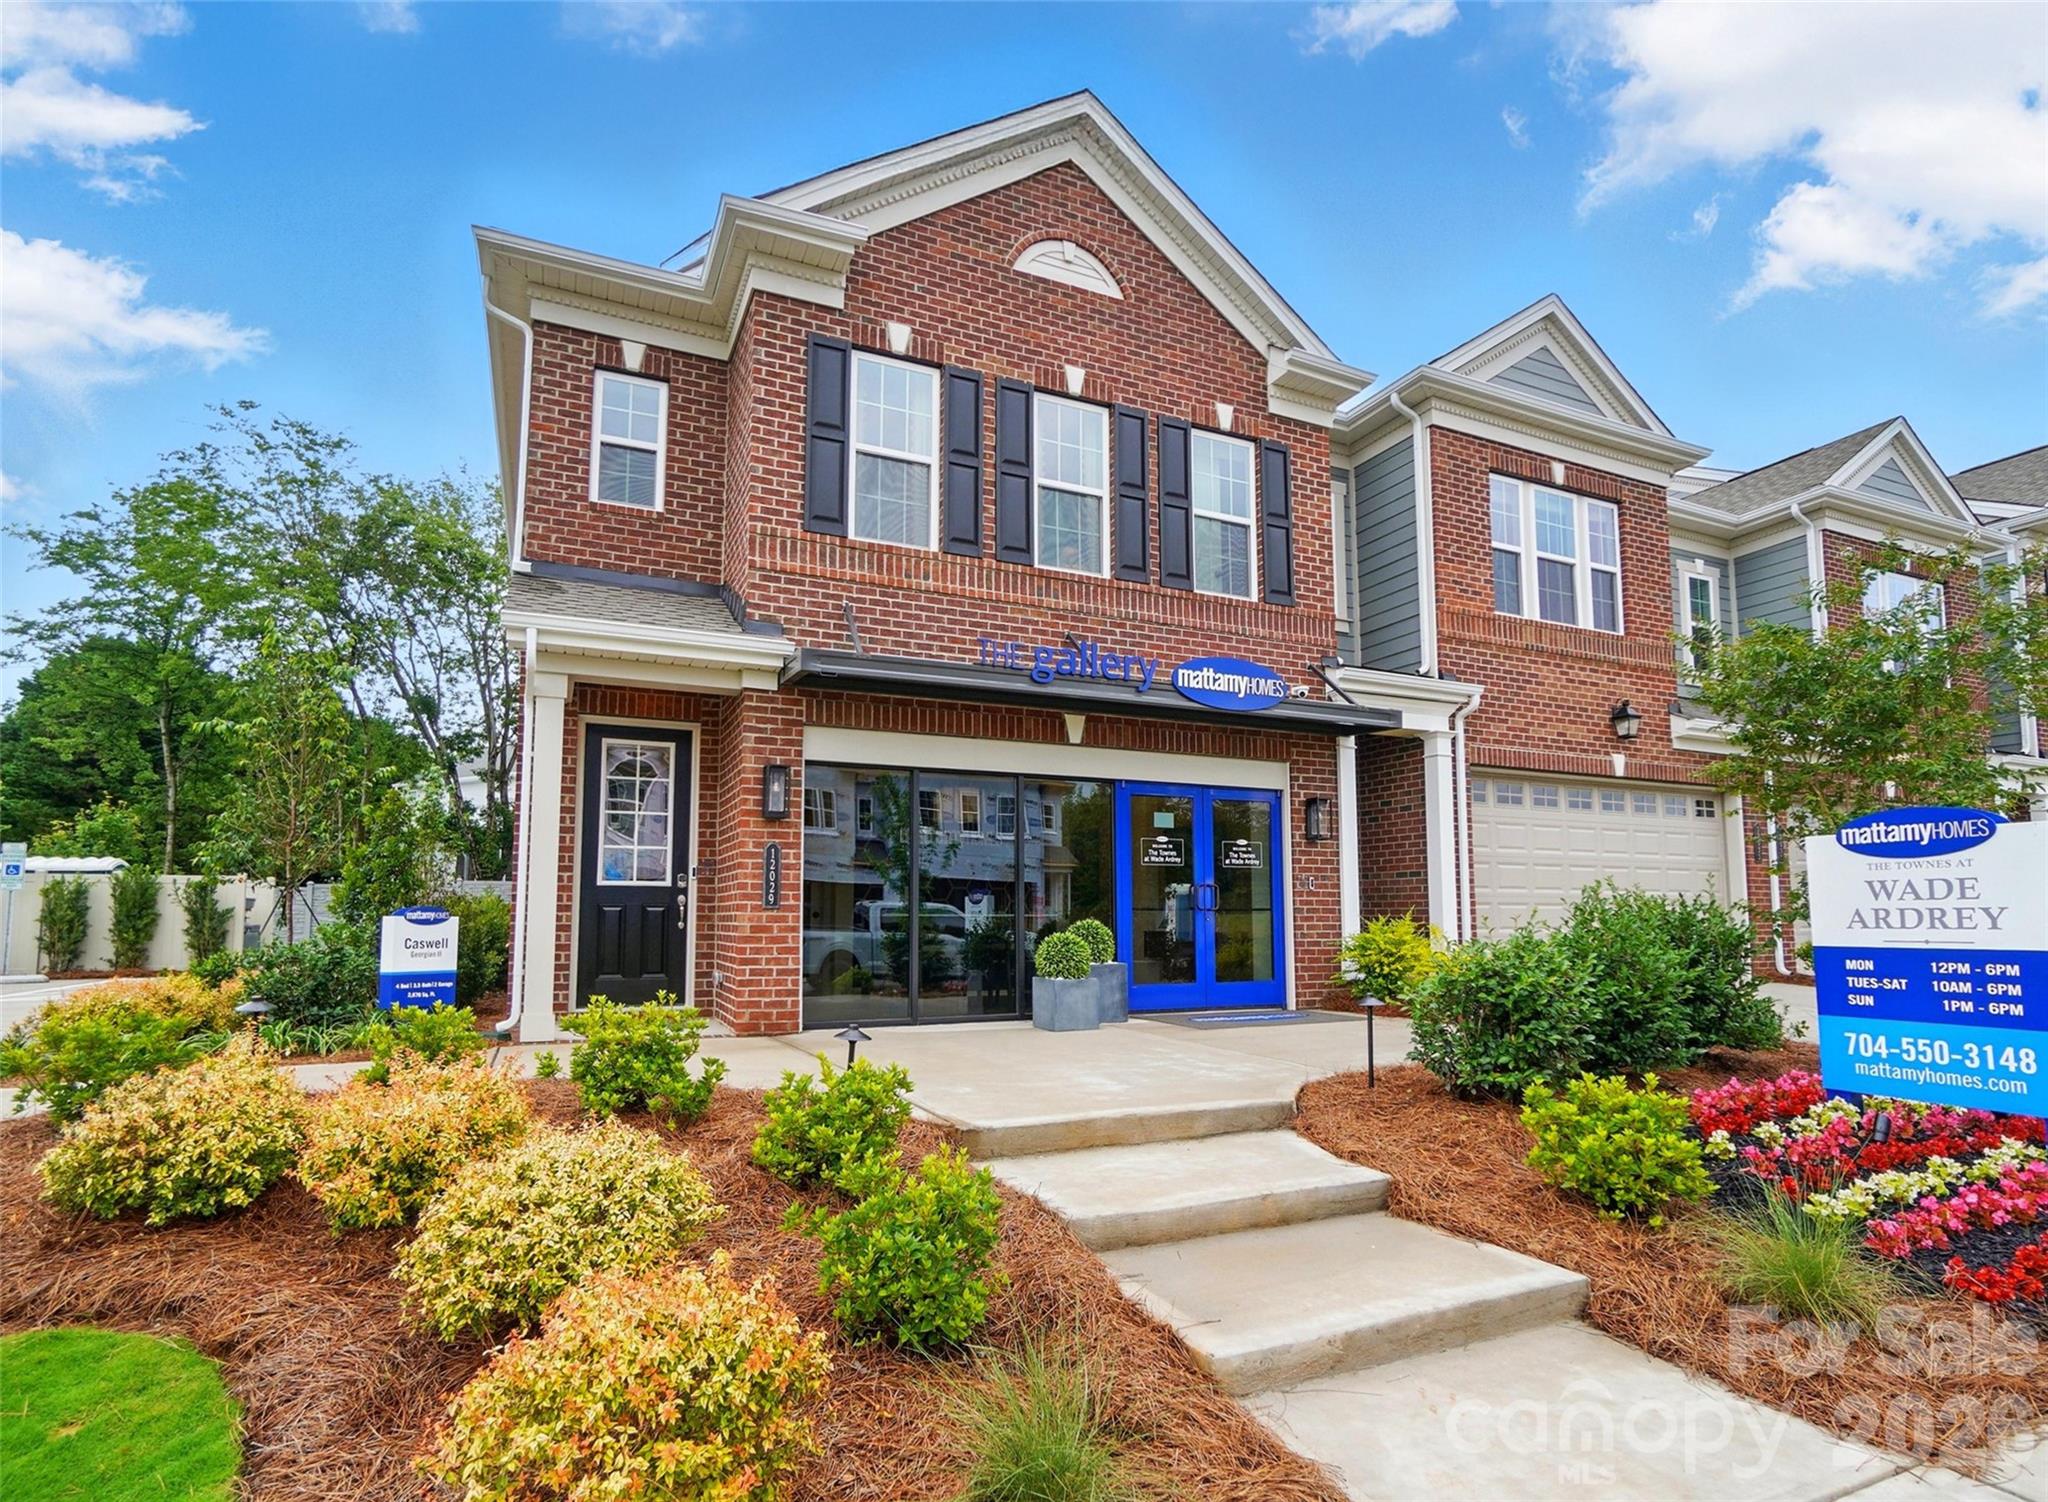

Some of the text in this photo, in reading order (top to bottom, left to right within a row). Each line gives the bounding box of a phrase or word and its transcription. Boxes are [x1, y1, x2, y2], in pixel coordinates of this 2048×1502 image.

[977, 637, 1159, 693] THE gallery
[768, 848, 776, 905] 12029
[1866, 858, 1974, 871] THE TOWNES AT
[1864, 877, 1982, 901] WADE
[1846, 906, 2008, 931] ARDREY
[404, 938, 449, 950] Caswell
[1845, 959, 1874, 971] MON
[1930, 962, 1971, 975] 12PM
[1985, 964, 2020, 977] 6PM
[1846, 976, 1908, 991] TUES-SAT
[1931, 980, 1972, 994] 10AM
[1987, 983, 2022, 997] 6PM
[1847, 994, 1875, 1006] SUN
[1942, 1000, 1974, 1013] 1PM
[1988, 1002, 2024, 1016] 6PM
[1844, 1032, 2037, 1075] 704-550-3148
[1855, 1062, 2028, 1095] mattamyhomes.com
